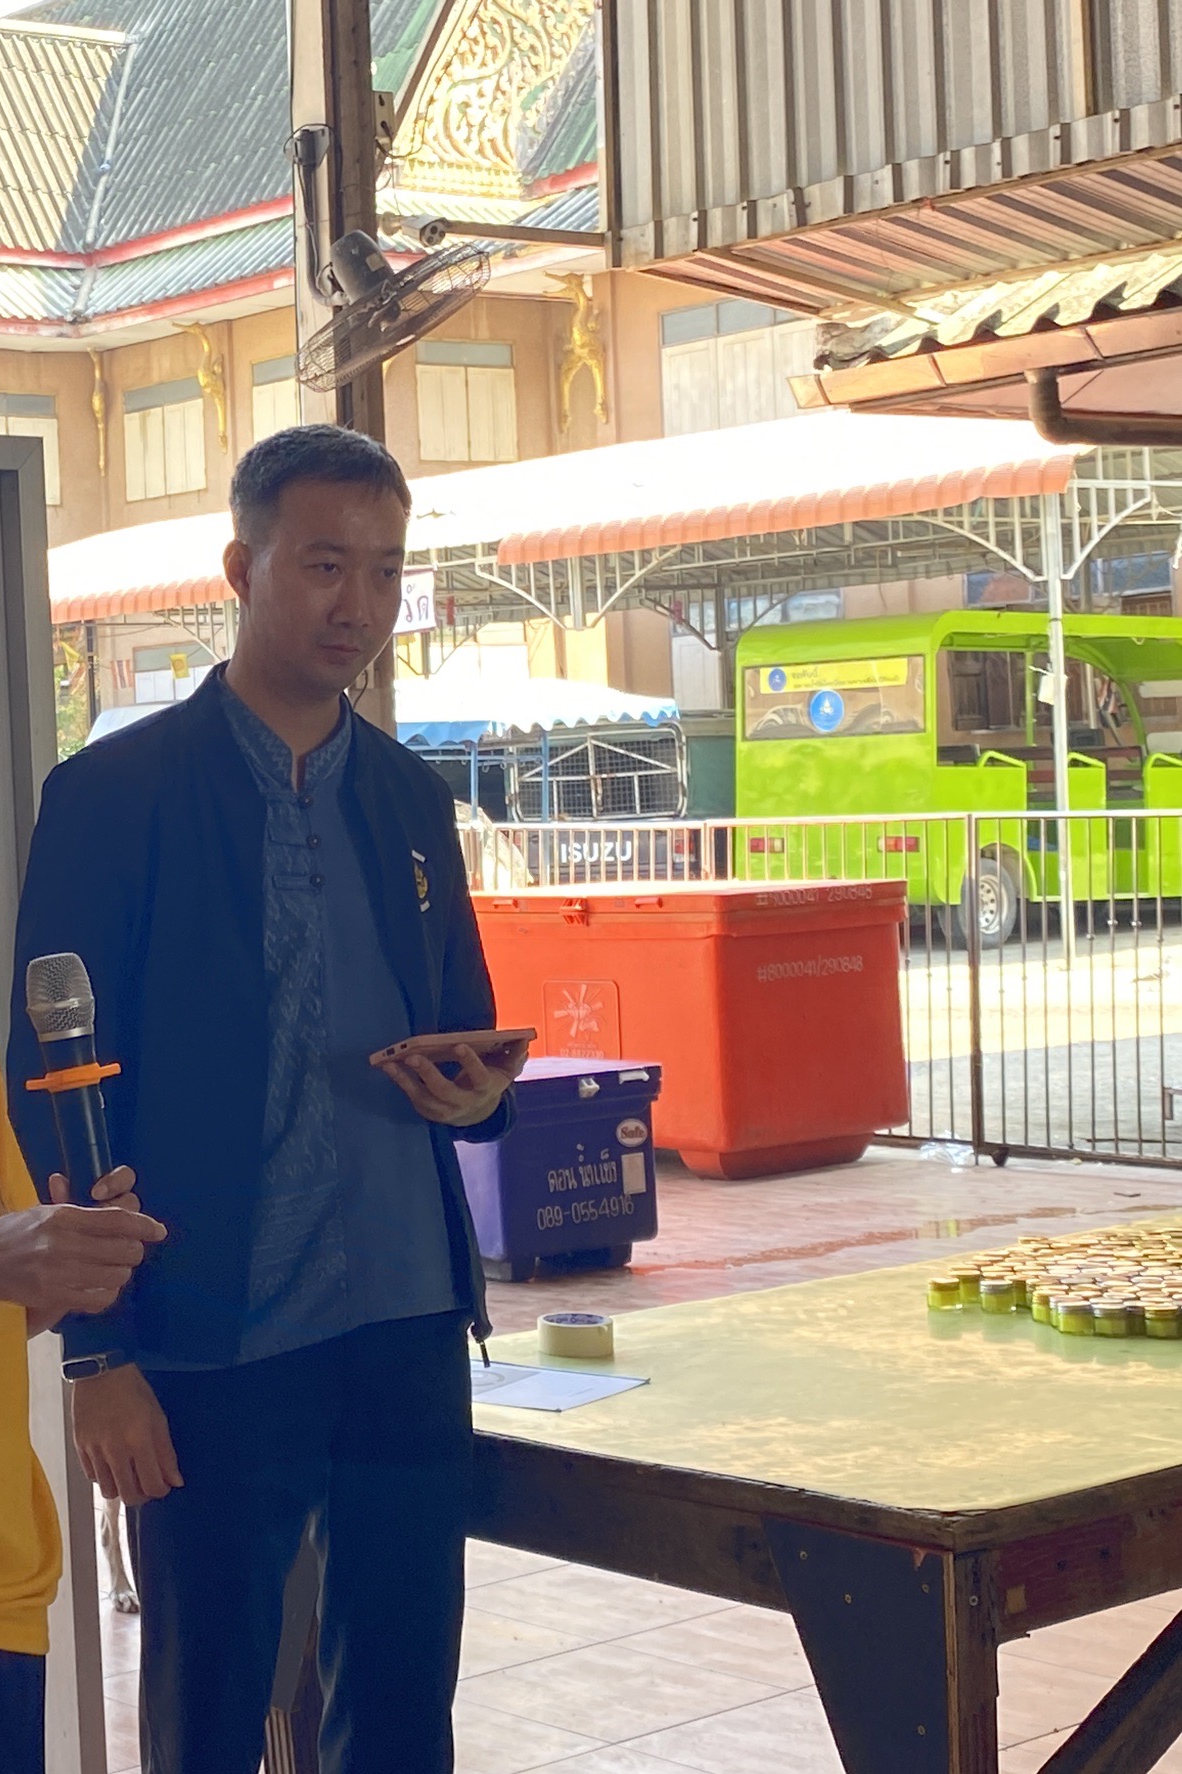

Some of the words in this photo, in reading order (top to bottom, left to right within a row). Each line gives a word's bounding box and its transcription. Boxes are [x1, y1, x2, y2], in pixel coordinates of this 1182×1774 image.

[560, 840, 632, 863] ISUZU
[620, 1126, 646, 1139] Safe
[536, 1194, 635, 1230] 089-0554916
